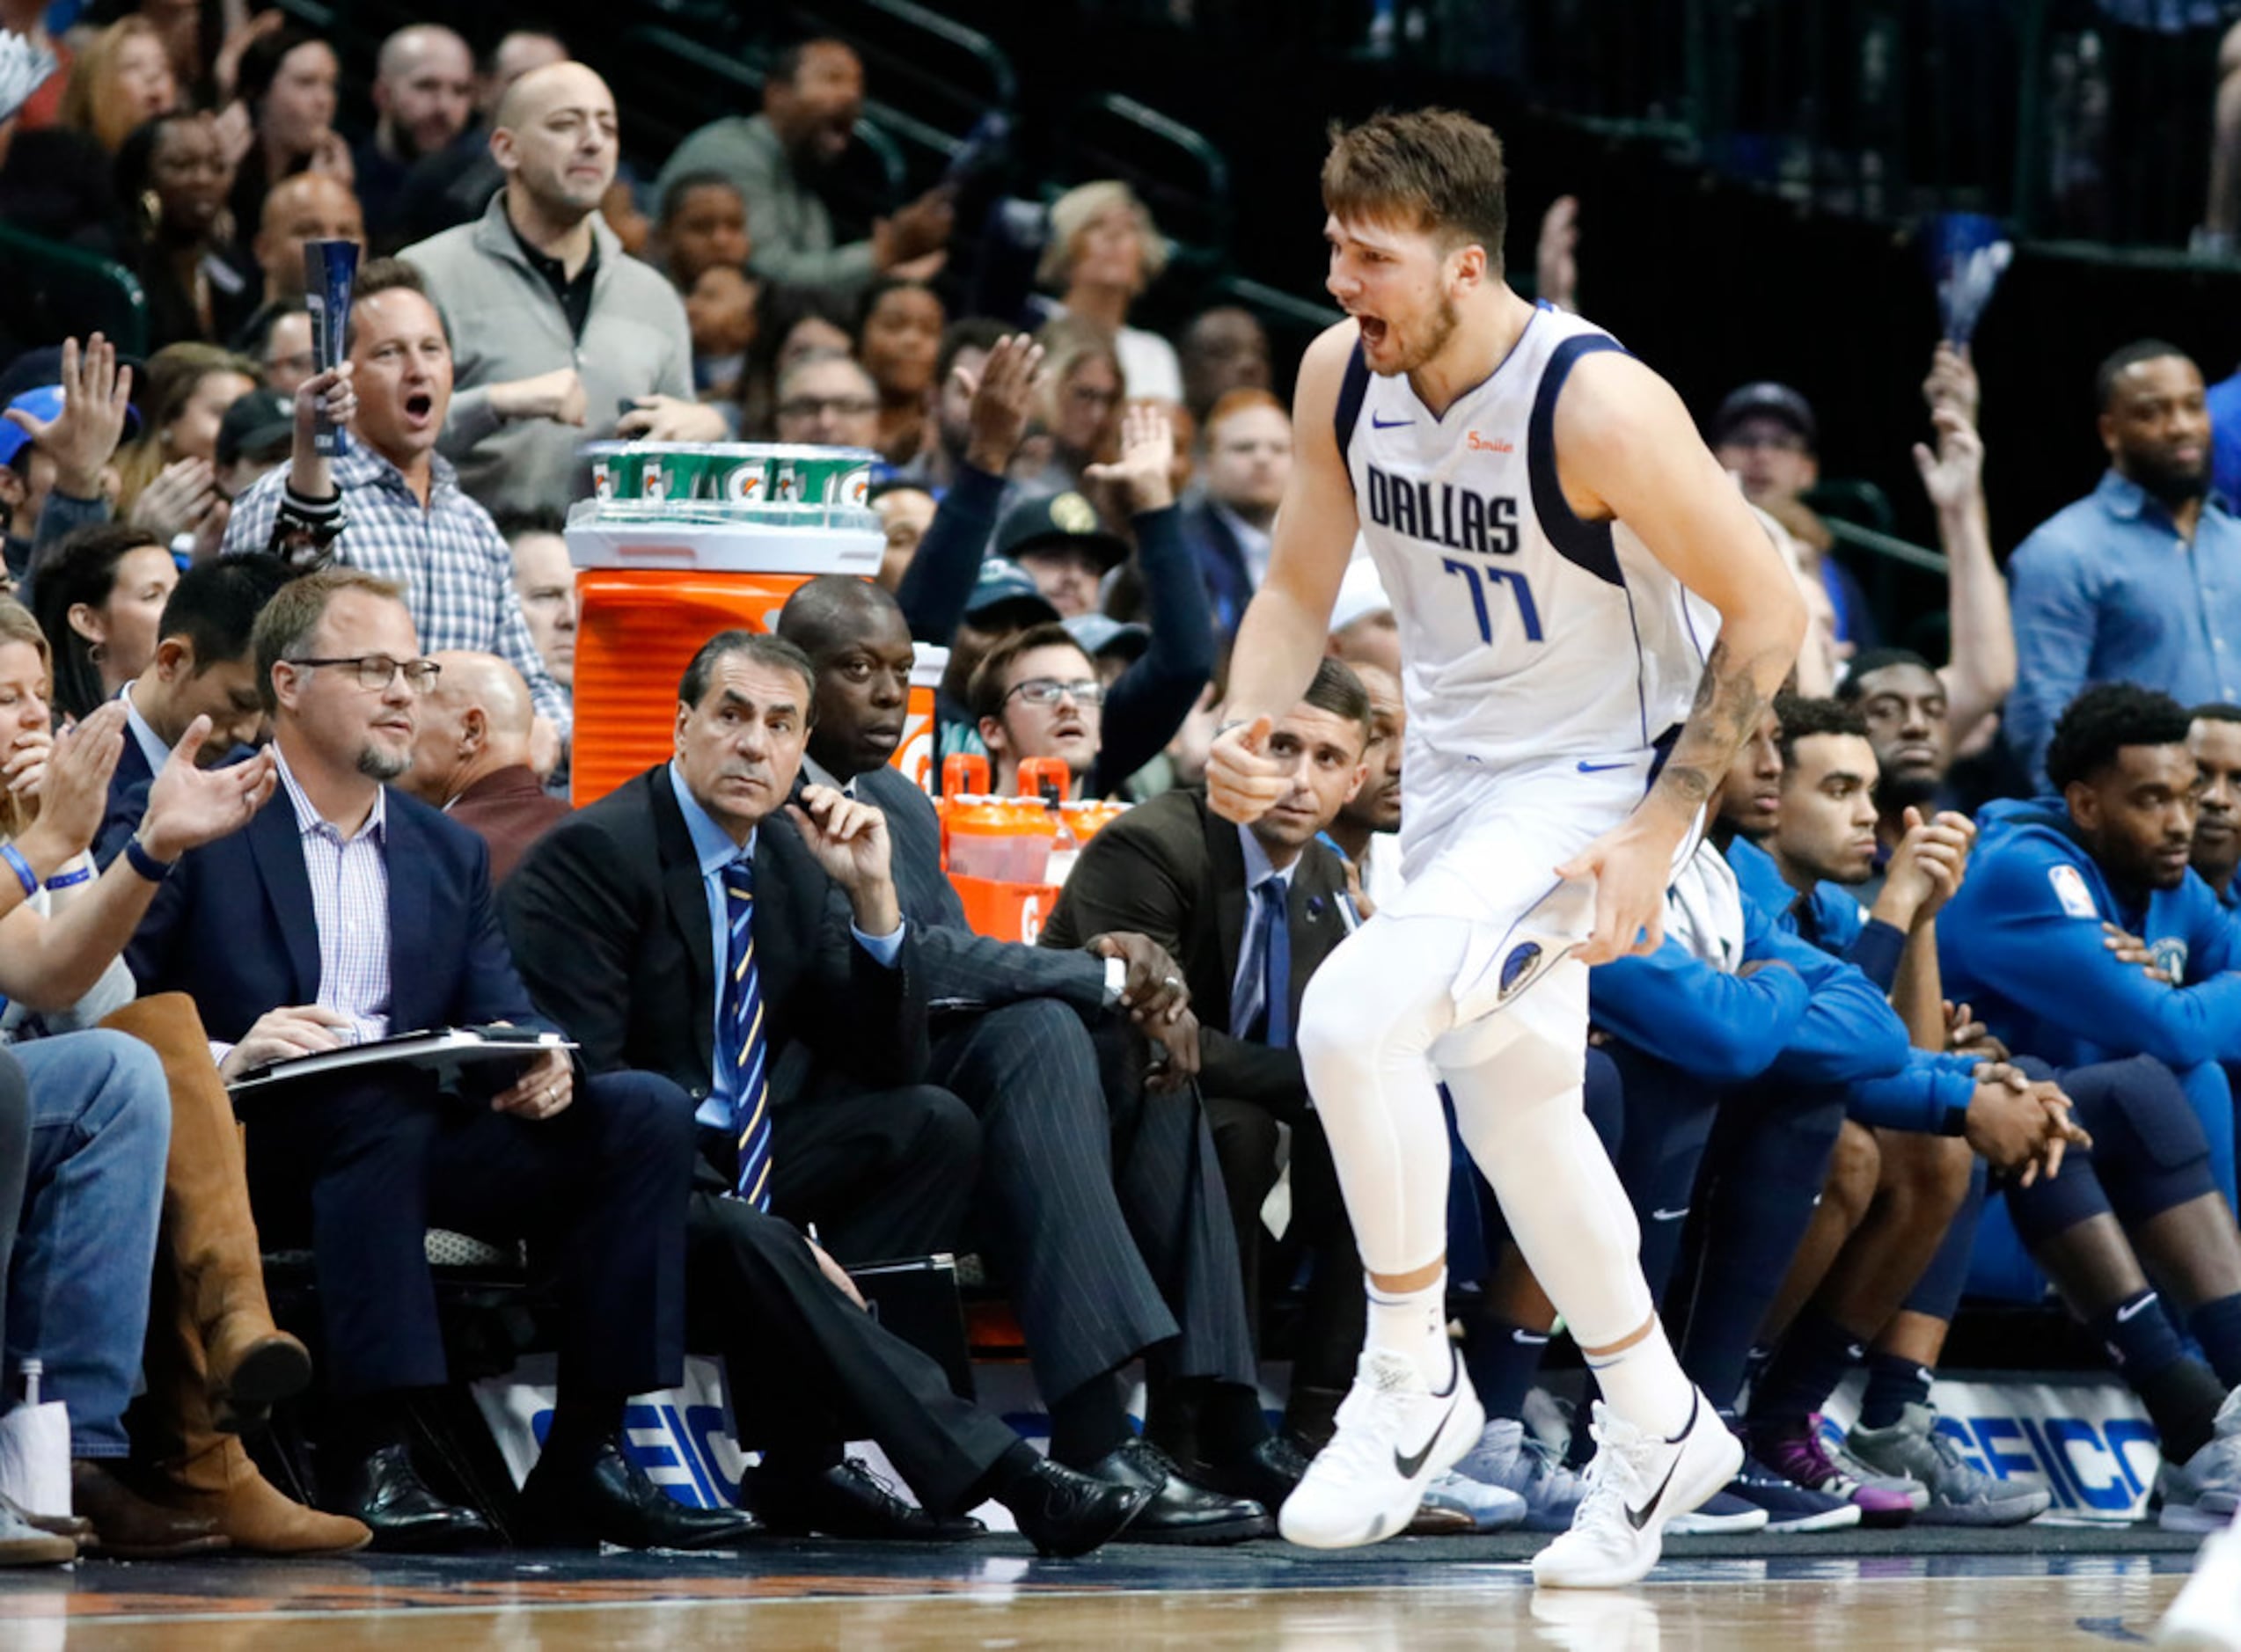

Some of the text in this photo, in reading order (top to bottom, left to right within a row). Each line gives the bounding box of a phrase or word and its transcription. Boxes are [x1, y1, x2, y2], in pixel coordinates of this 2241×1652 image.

[729, 466, 765, 506] G
[839, 471, 870, 508] G
[1366, 464, 1519, 555] DALLAS
[1441, 557, 1544, 645] 77
[1022, 895, 1039, 946] G
